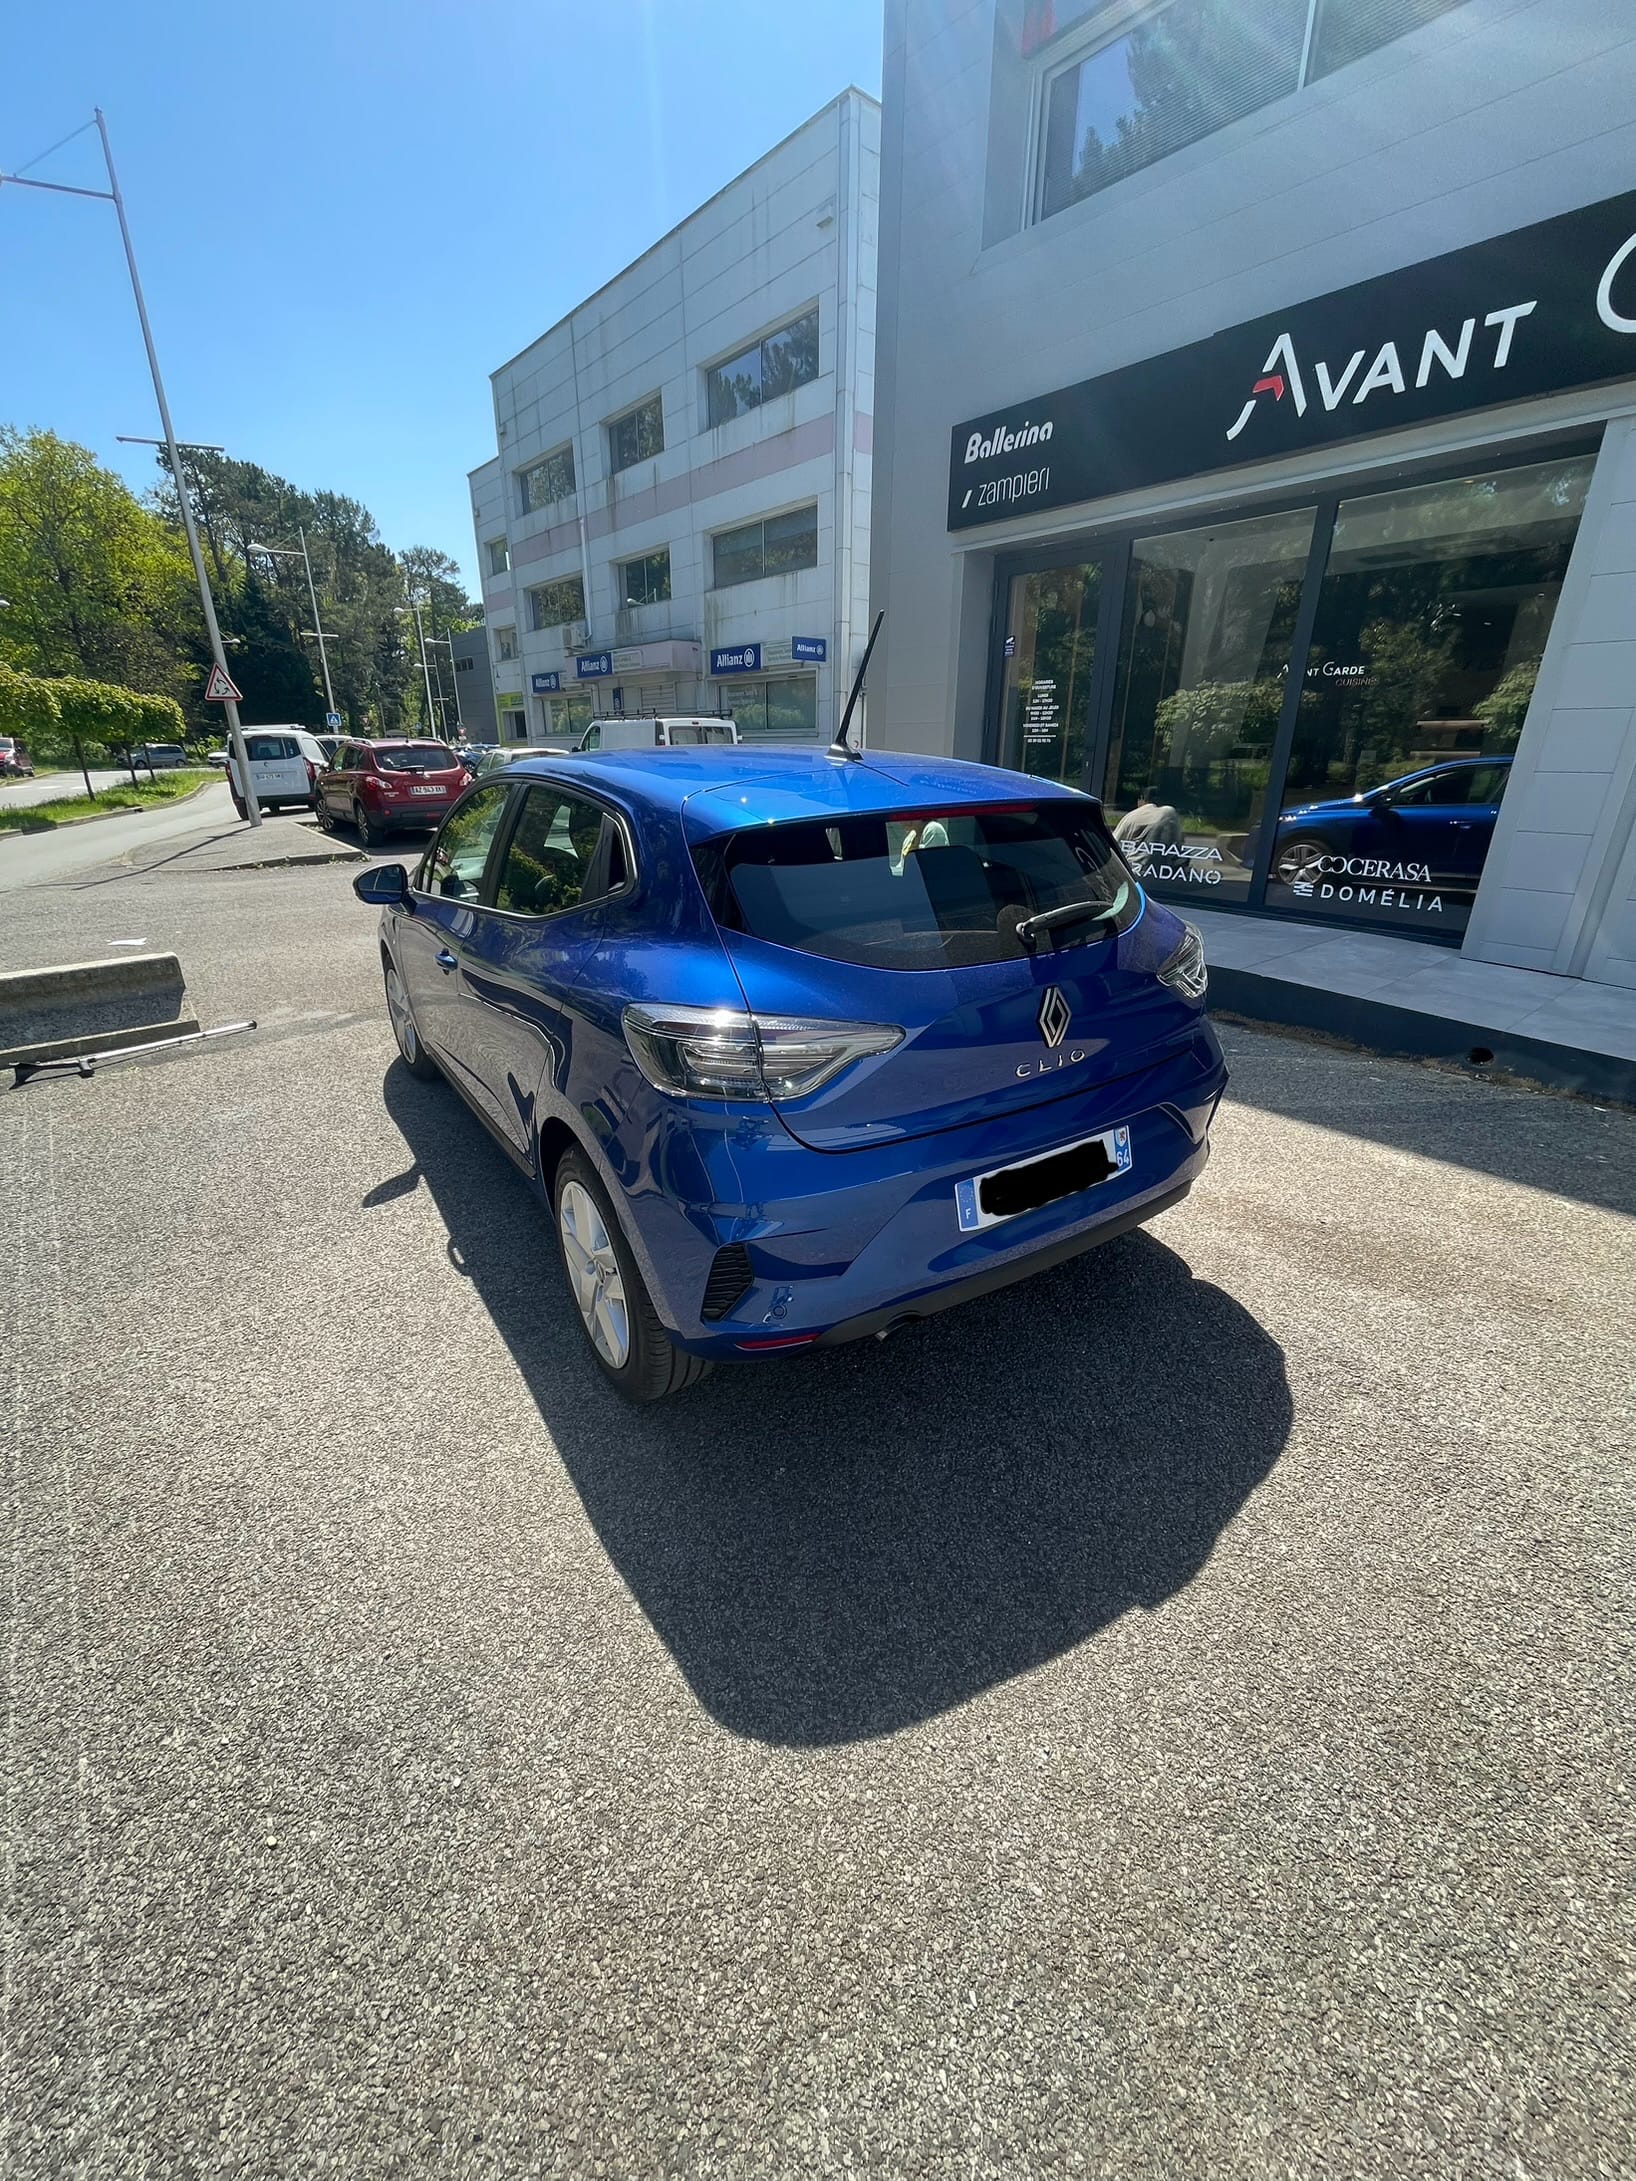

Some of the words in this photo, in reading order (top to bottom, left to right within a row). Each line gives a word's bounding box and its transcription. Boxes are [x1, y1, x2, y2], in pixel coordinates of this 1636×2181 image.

[1226, 300, 1537, 440] AVANT
[964, 421, 1053, 464] Ballerina
[977, 466, 1050, 506] zampieri
[797, 643, 816, 653] Allianz
[581, 660, 600, 672] Allianz
[717, 653, 743, 667] Allianz
[1322, 661, 1365, 676] GARDE
[1120, 840, 1223, 861] BARAZZA
[1131, 862, 1222, 885] RADANO
[1318, 855, 1432, 883] COCERASA
[1320, 884, 1443, 912] DOMÉLIA
[1016, 1050, 1085, 1078] CLIO
[1116, 1149, 1130, 1167] 64
[965, 1208, 972, 1219] F
